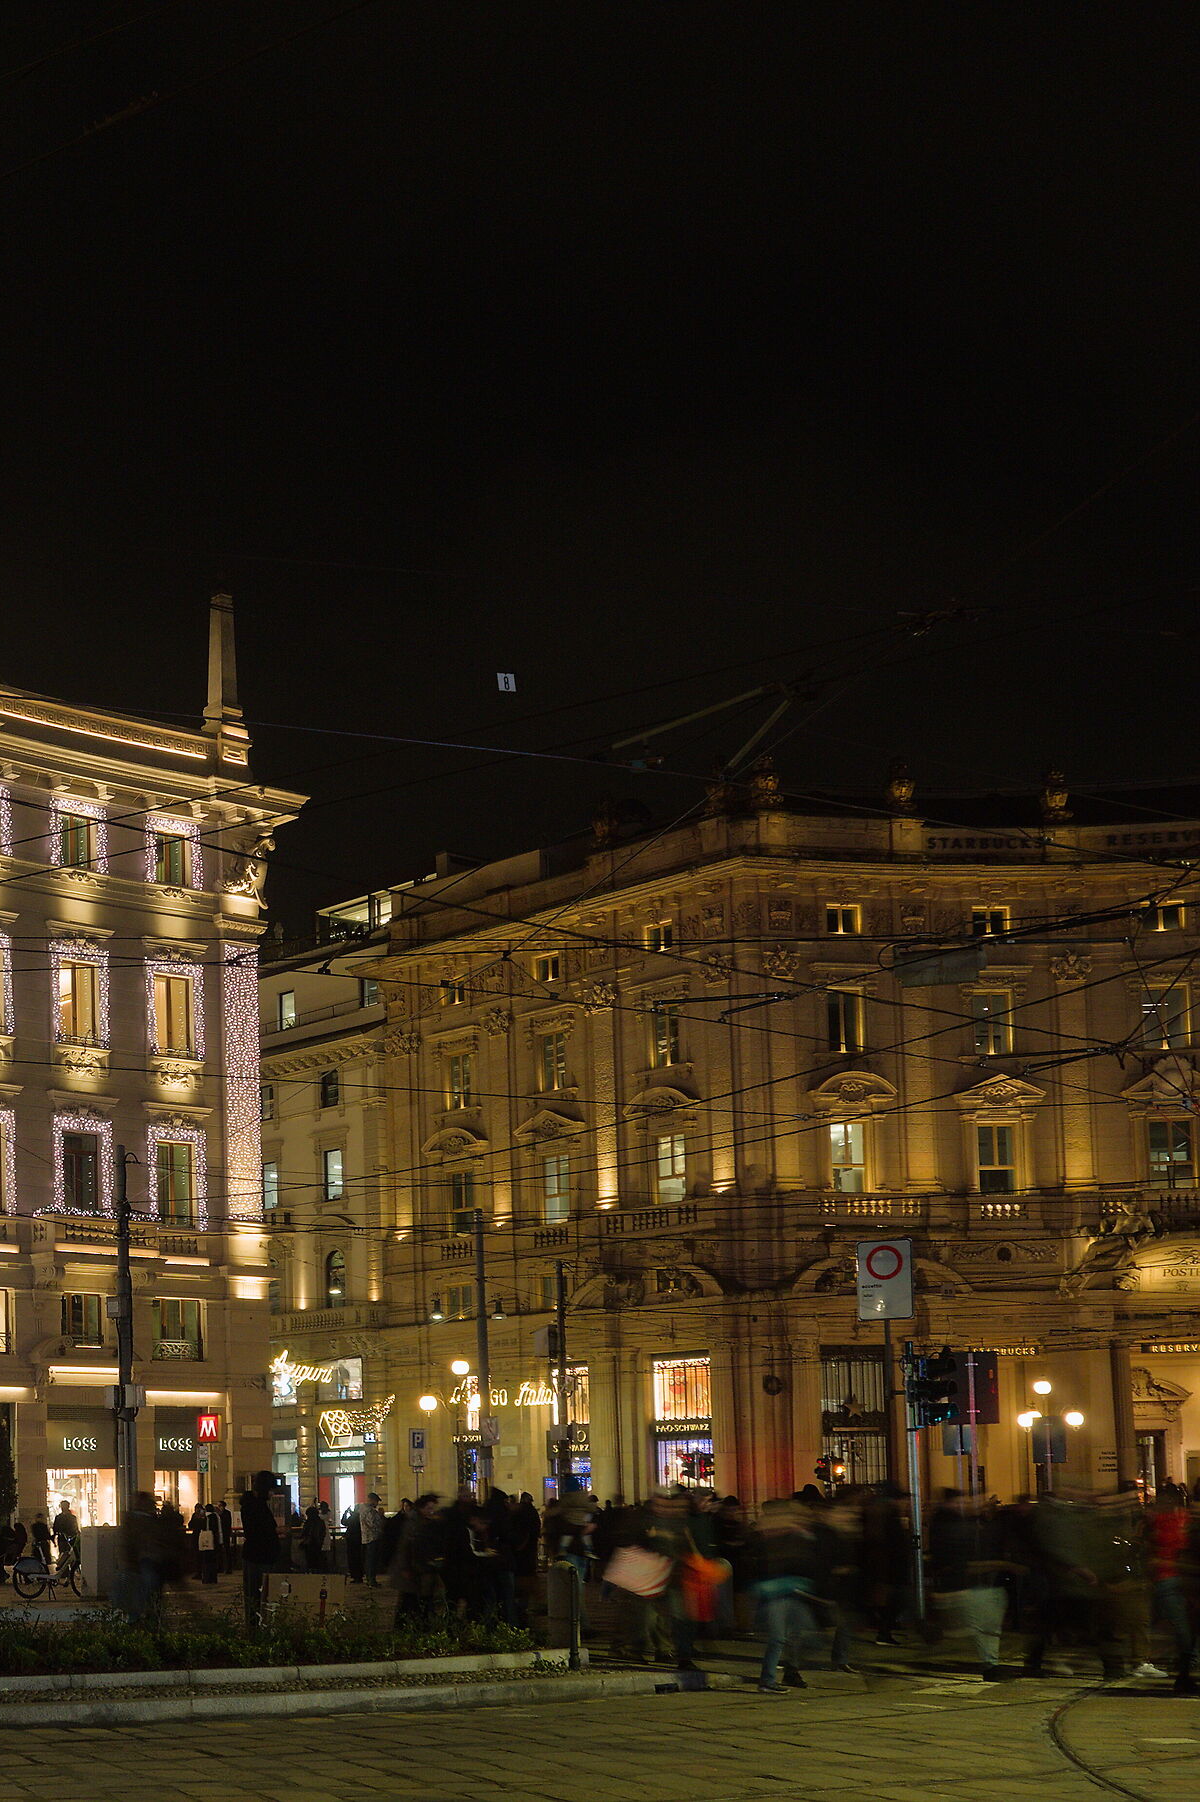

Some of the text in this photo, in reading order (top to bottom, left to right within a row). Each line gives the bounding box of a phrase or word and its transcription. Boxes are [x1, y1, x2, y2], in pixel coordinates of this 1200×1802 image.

[927, 837, 1045, 850] STARBUCKS
[269, 1350, 335, 1386] Auguri
[200, 1419, 216, 1437] M
[63, 1437, 97, 1451] BOSS
[159, 1437, 193, 1451] BOSS
[415, 1434, 421, 1447] P
